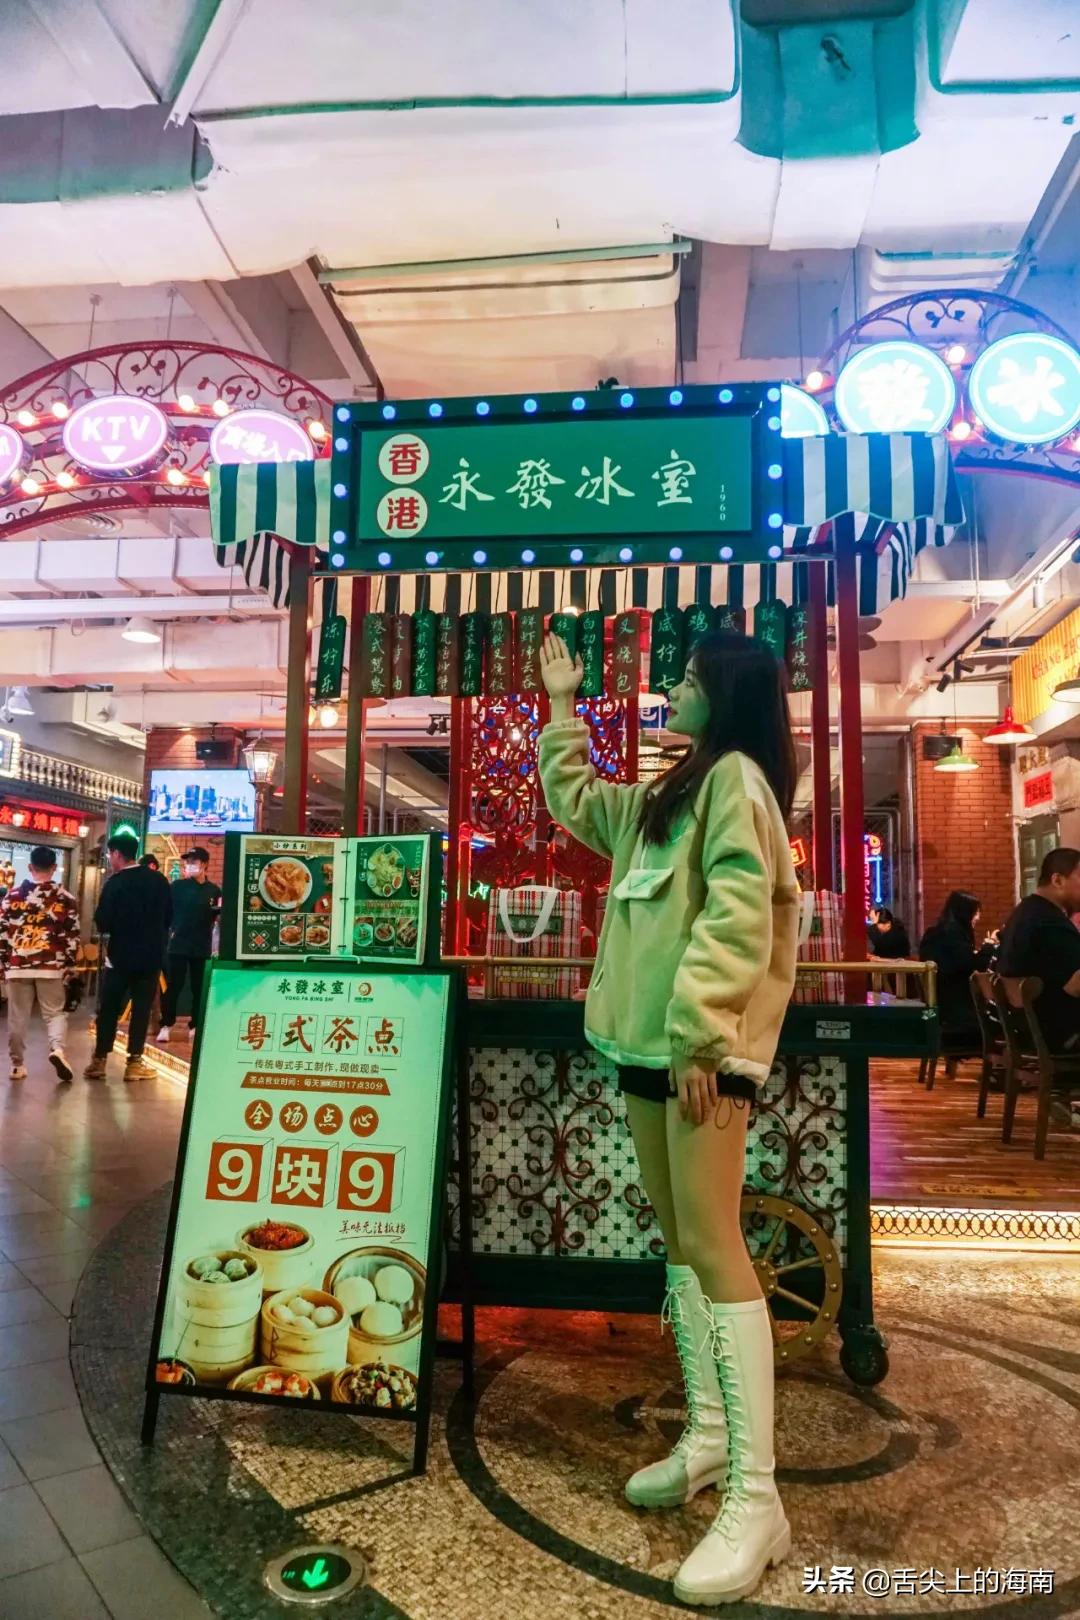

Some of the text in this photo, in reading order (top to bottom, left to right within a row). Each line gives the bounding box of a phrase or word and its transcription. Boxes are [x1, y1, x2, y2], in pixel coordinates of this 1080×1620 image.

[82, 415, 151, 442] KTV
[386, 441, 422, 532] 香港
[438, 448, 698, 511] 永發冰室
[718, 484, 727, 521] 1960
[321, 622, 340, 693] 冻柠乐
[616, 617, 635, 693] 叉烧包
[656, 613, 677, 690] 咸柠七
[273, 842, 307, 850] 小炒系列
[276, 979, 345, 997] 永發冰室
[239, 1014, 400, 1056] 粤式茶点
[250, 1103, 373, 1128] 全场点心
[217, 1147, 387, 1207] 9块9
